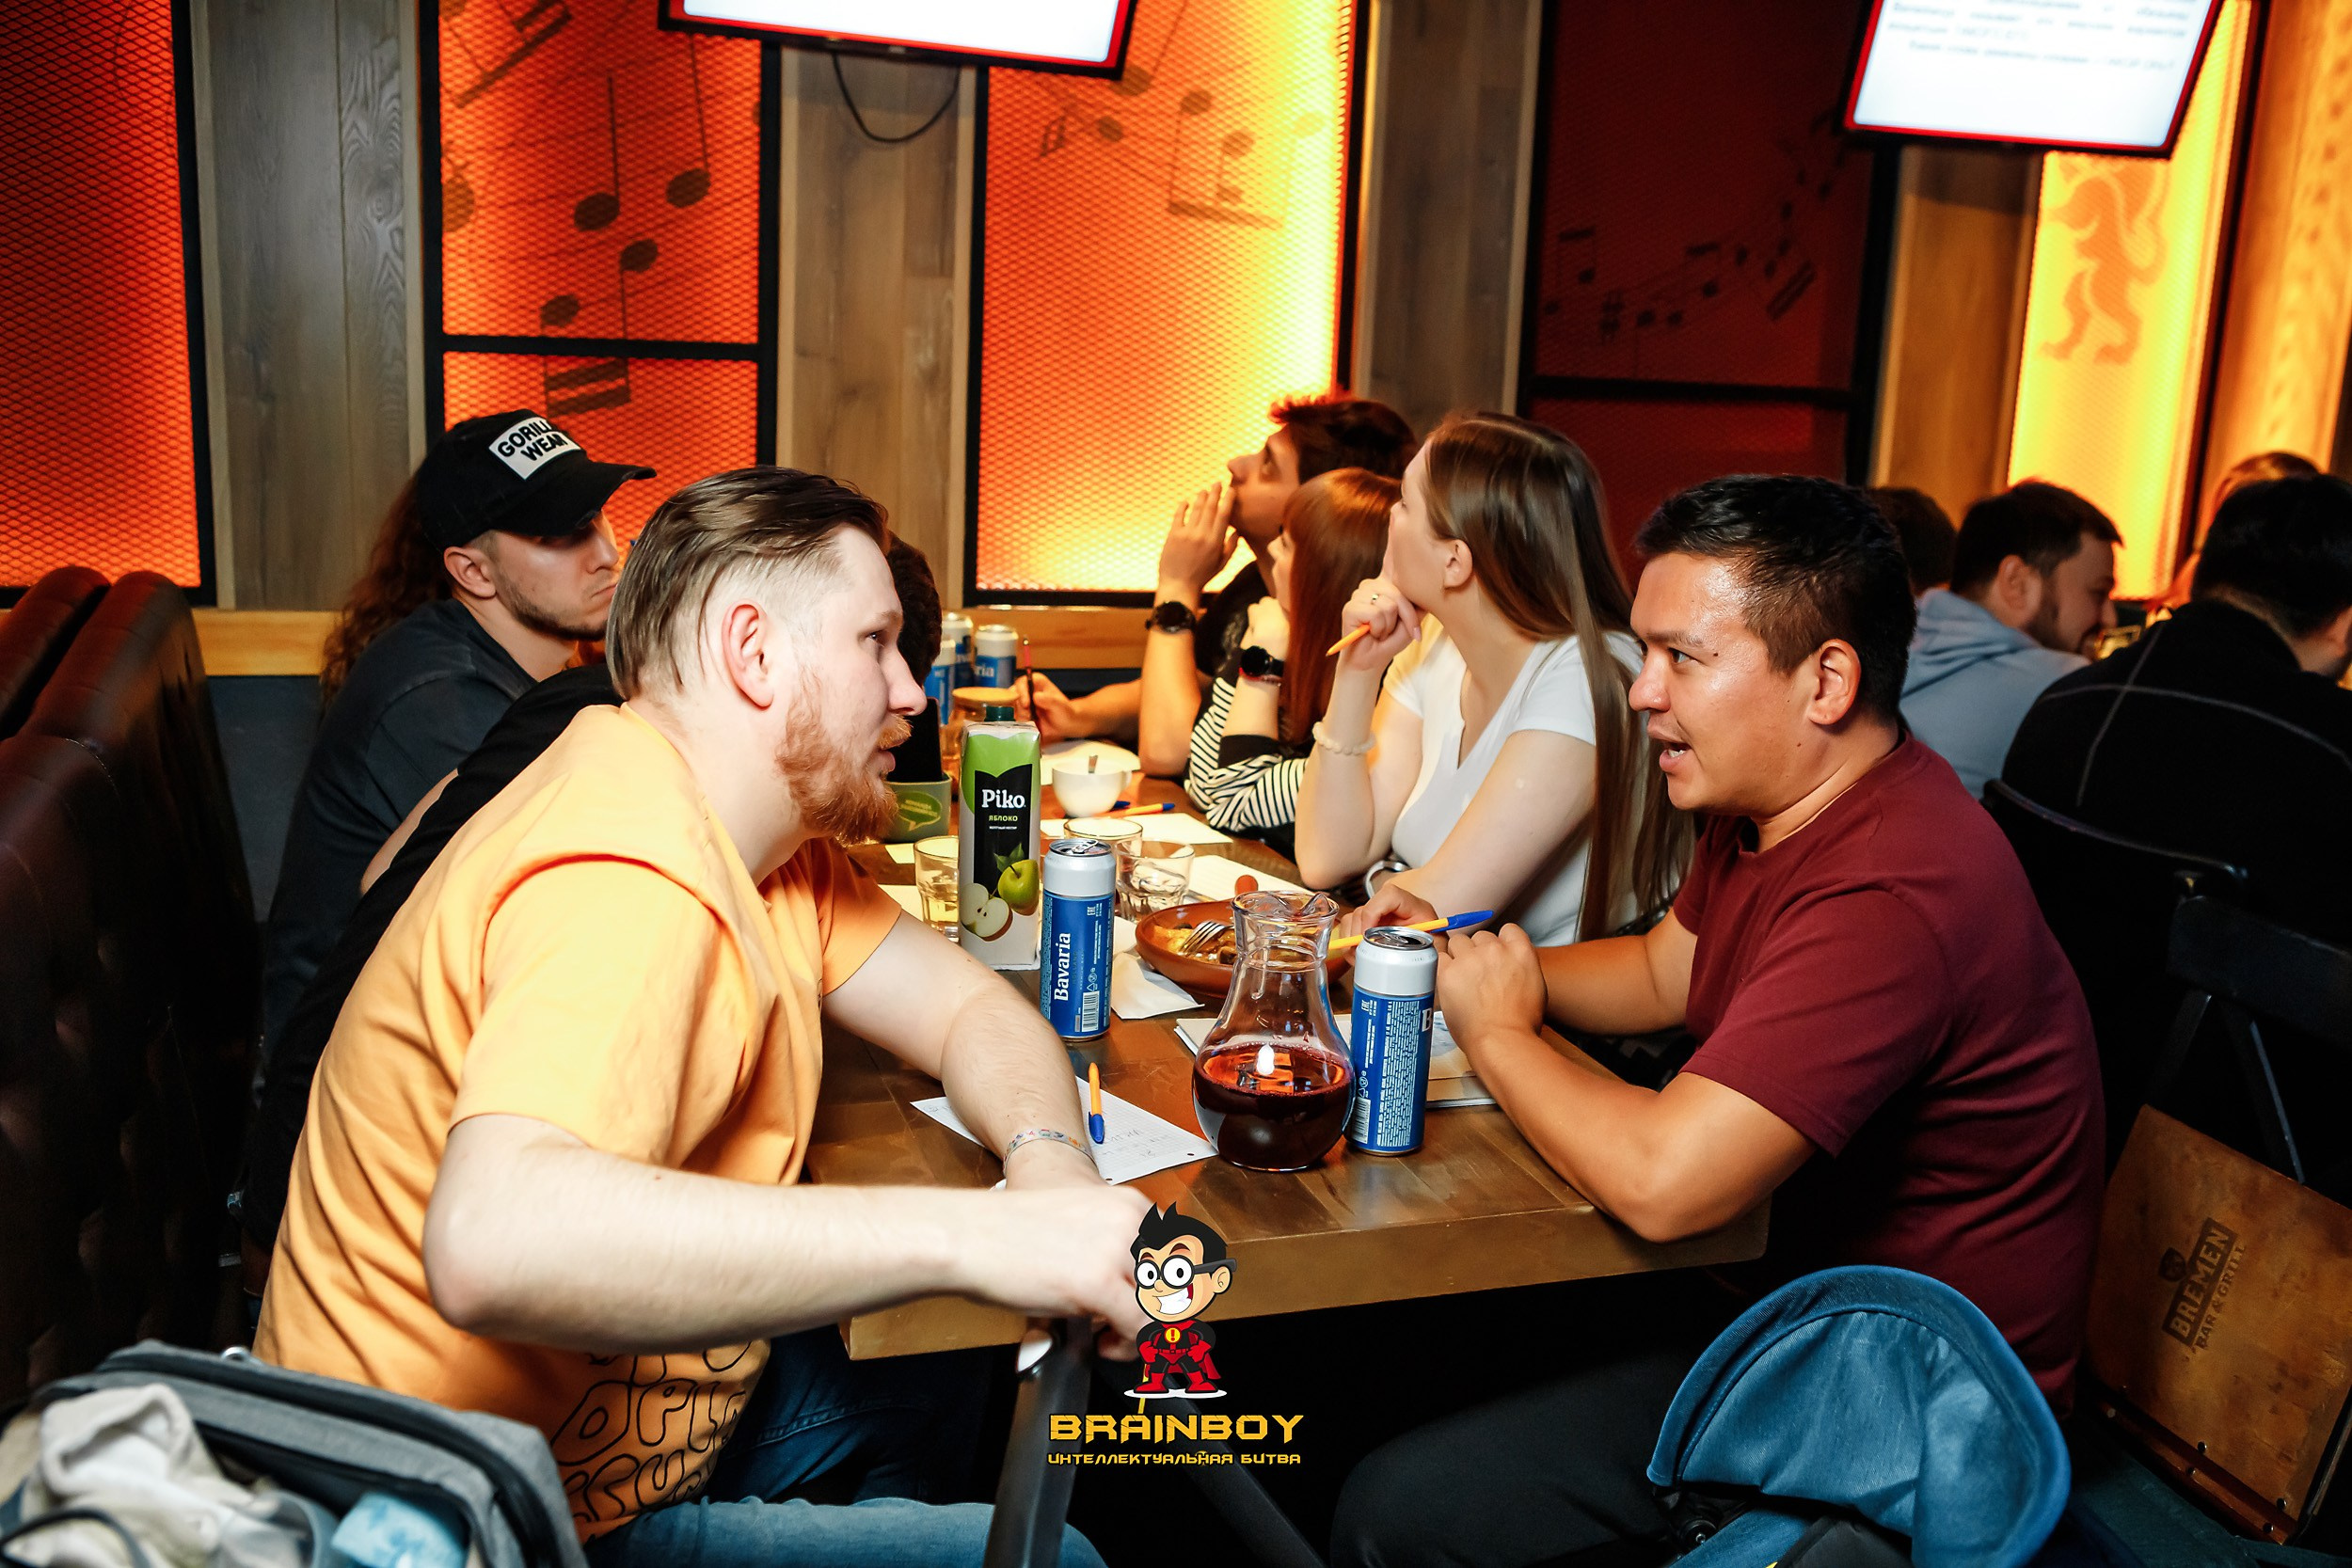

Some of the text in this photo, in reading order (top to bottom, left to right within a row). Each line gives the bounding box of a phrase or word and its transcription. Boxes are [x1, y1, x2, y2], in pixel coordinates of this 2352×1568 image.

[498, 420, 552, 457] GORILL
[520, 434, 568, 461] WEAR
[981, 789, 1025, 809] Piko
[1054, 933, 1071, 1001] Bavaria
[2169, 1227, 2231, 1338] BREMEN
[2195, 1314, 2217, 1350] BAR
[2217, 1245, 2247, 1297] GRILL
